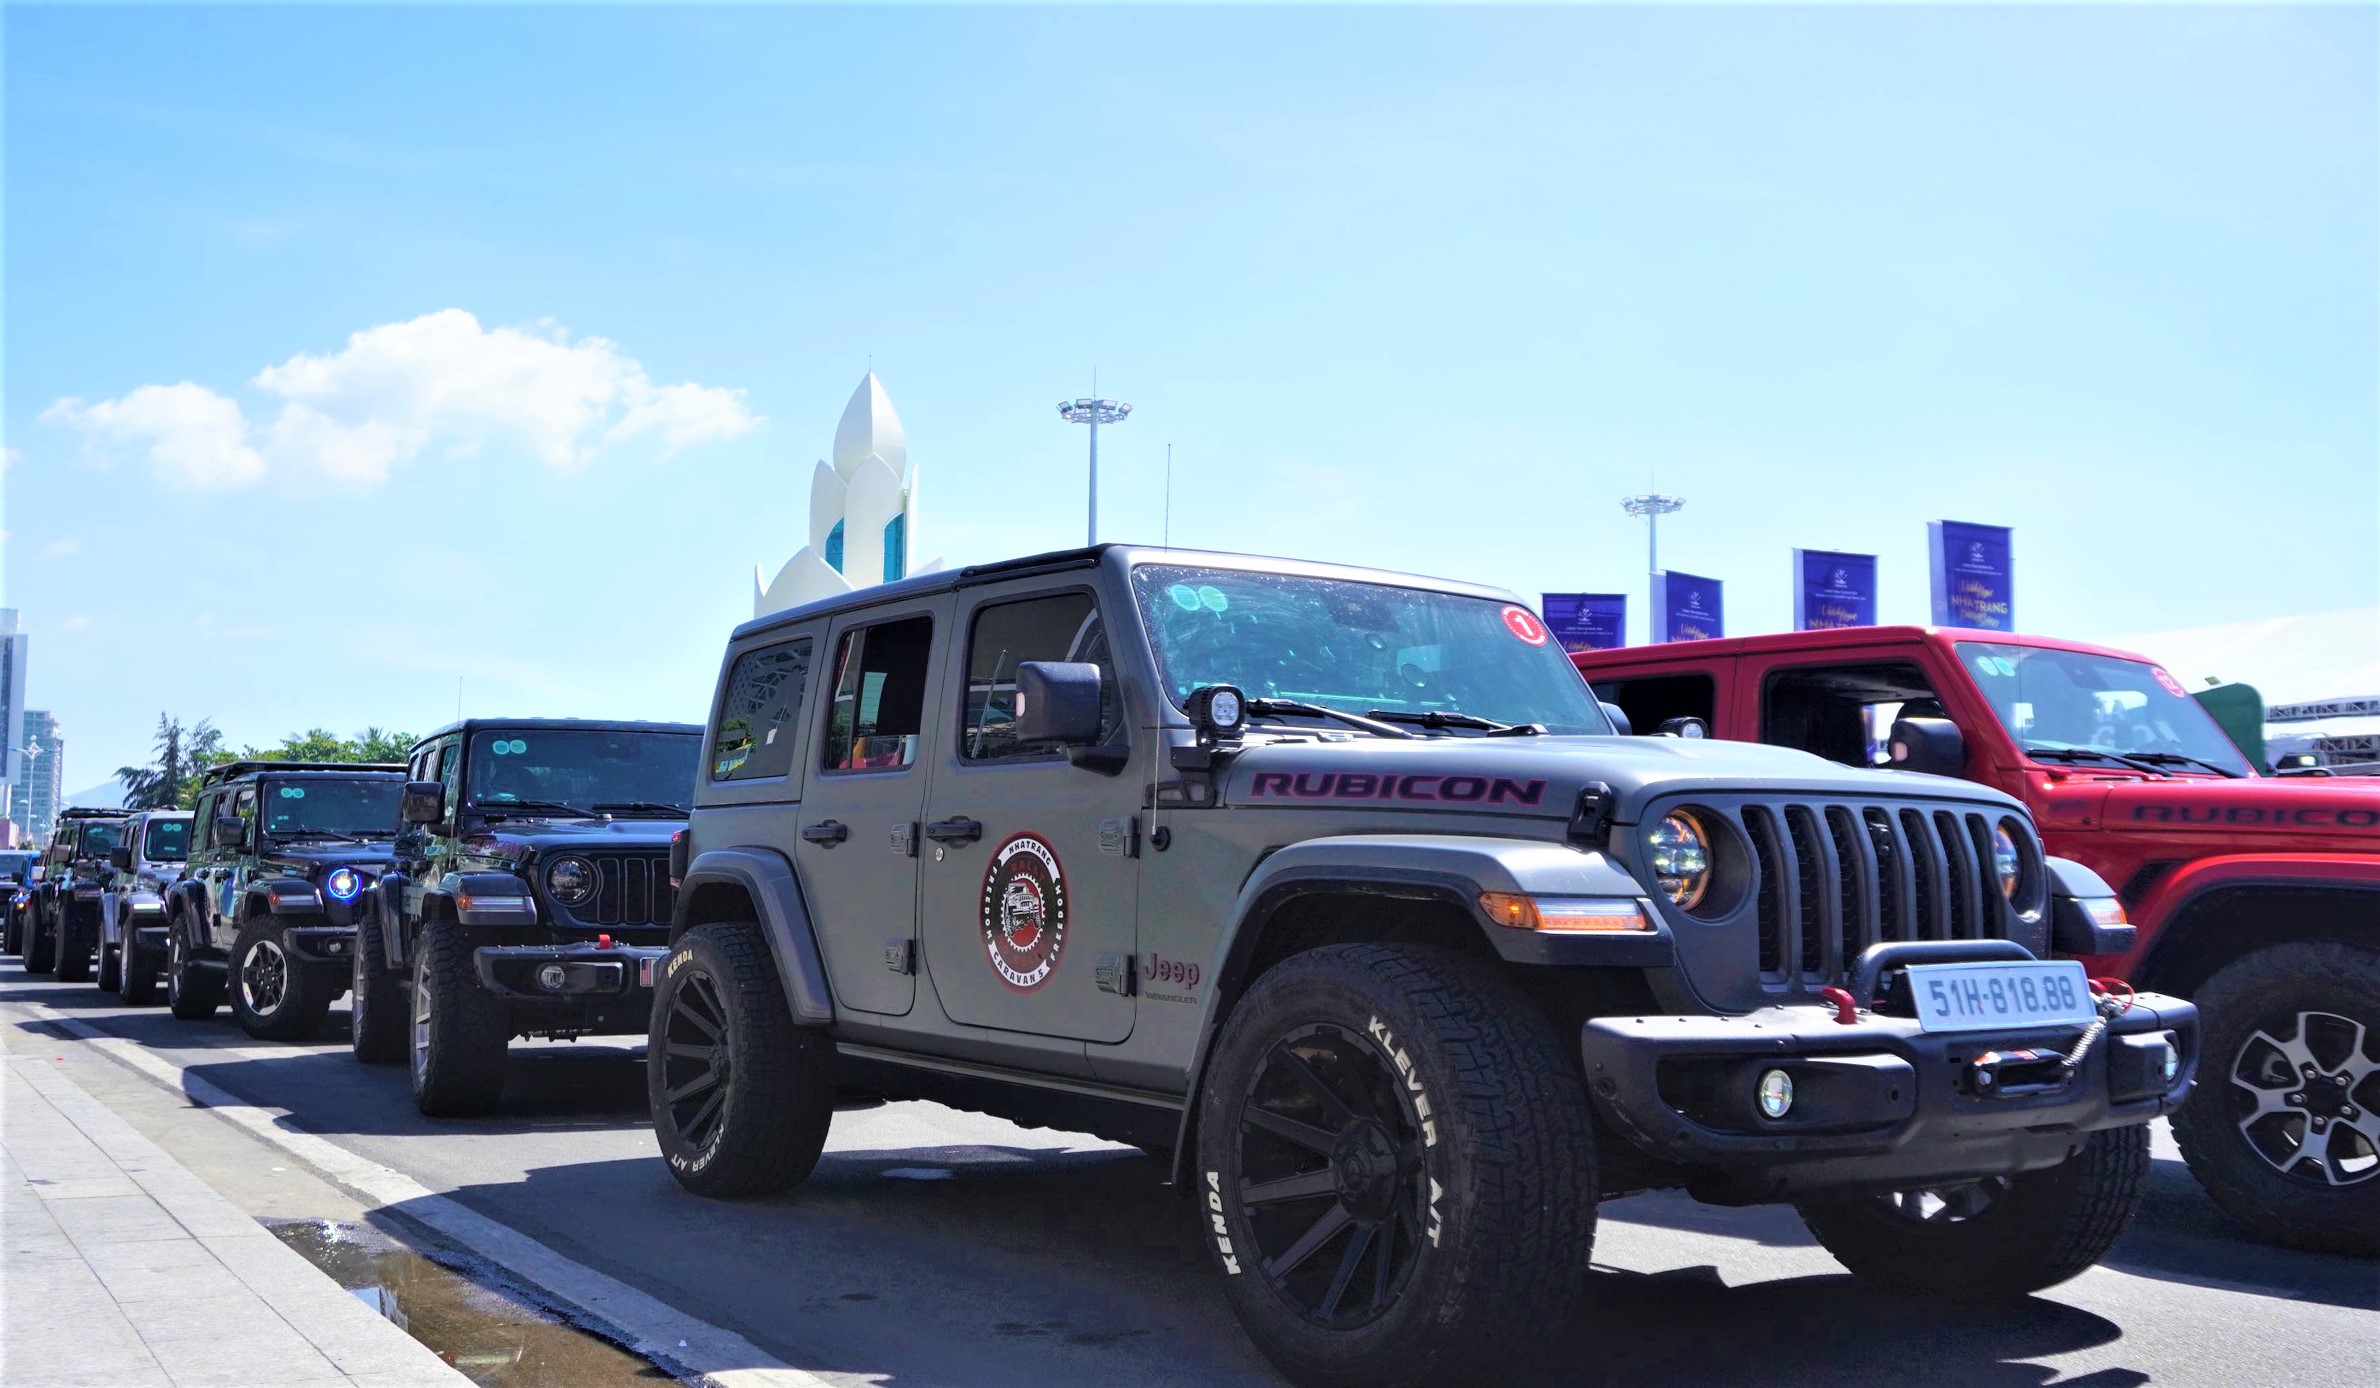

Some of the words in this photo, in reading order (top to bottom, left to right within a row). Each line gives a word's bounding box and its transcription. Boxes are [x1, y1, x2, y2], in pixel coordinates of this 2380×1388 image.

[1514, 614, 1534, 637] 1
[1975, 600, 2008, 614] TRANG
[1250, 772, 1547, 805] RUBICON
[984, 866, 998, 940] FREEDOM
[1050, 884, 1064, 961] FREEDOM
[667, 949, 694, 979] KENDA
[993, 951, 1036, 985] CARAVAN
[1144, 952, 1199, 990] Jeep
[1928, 975, 2077, 1017] 51H-818.88
[1368, 1015, 1437, 1148] KLEVER
[1206, 1171, 1242, 1275] KENDA
